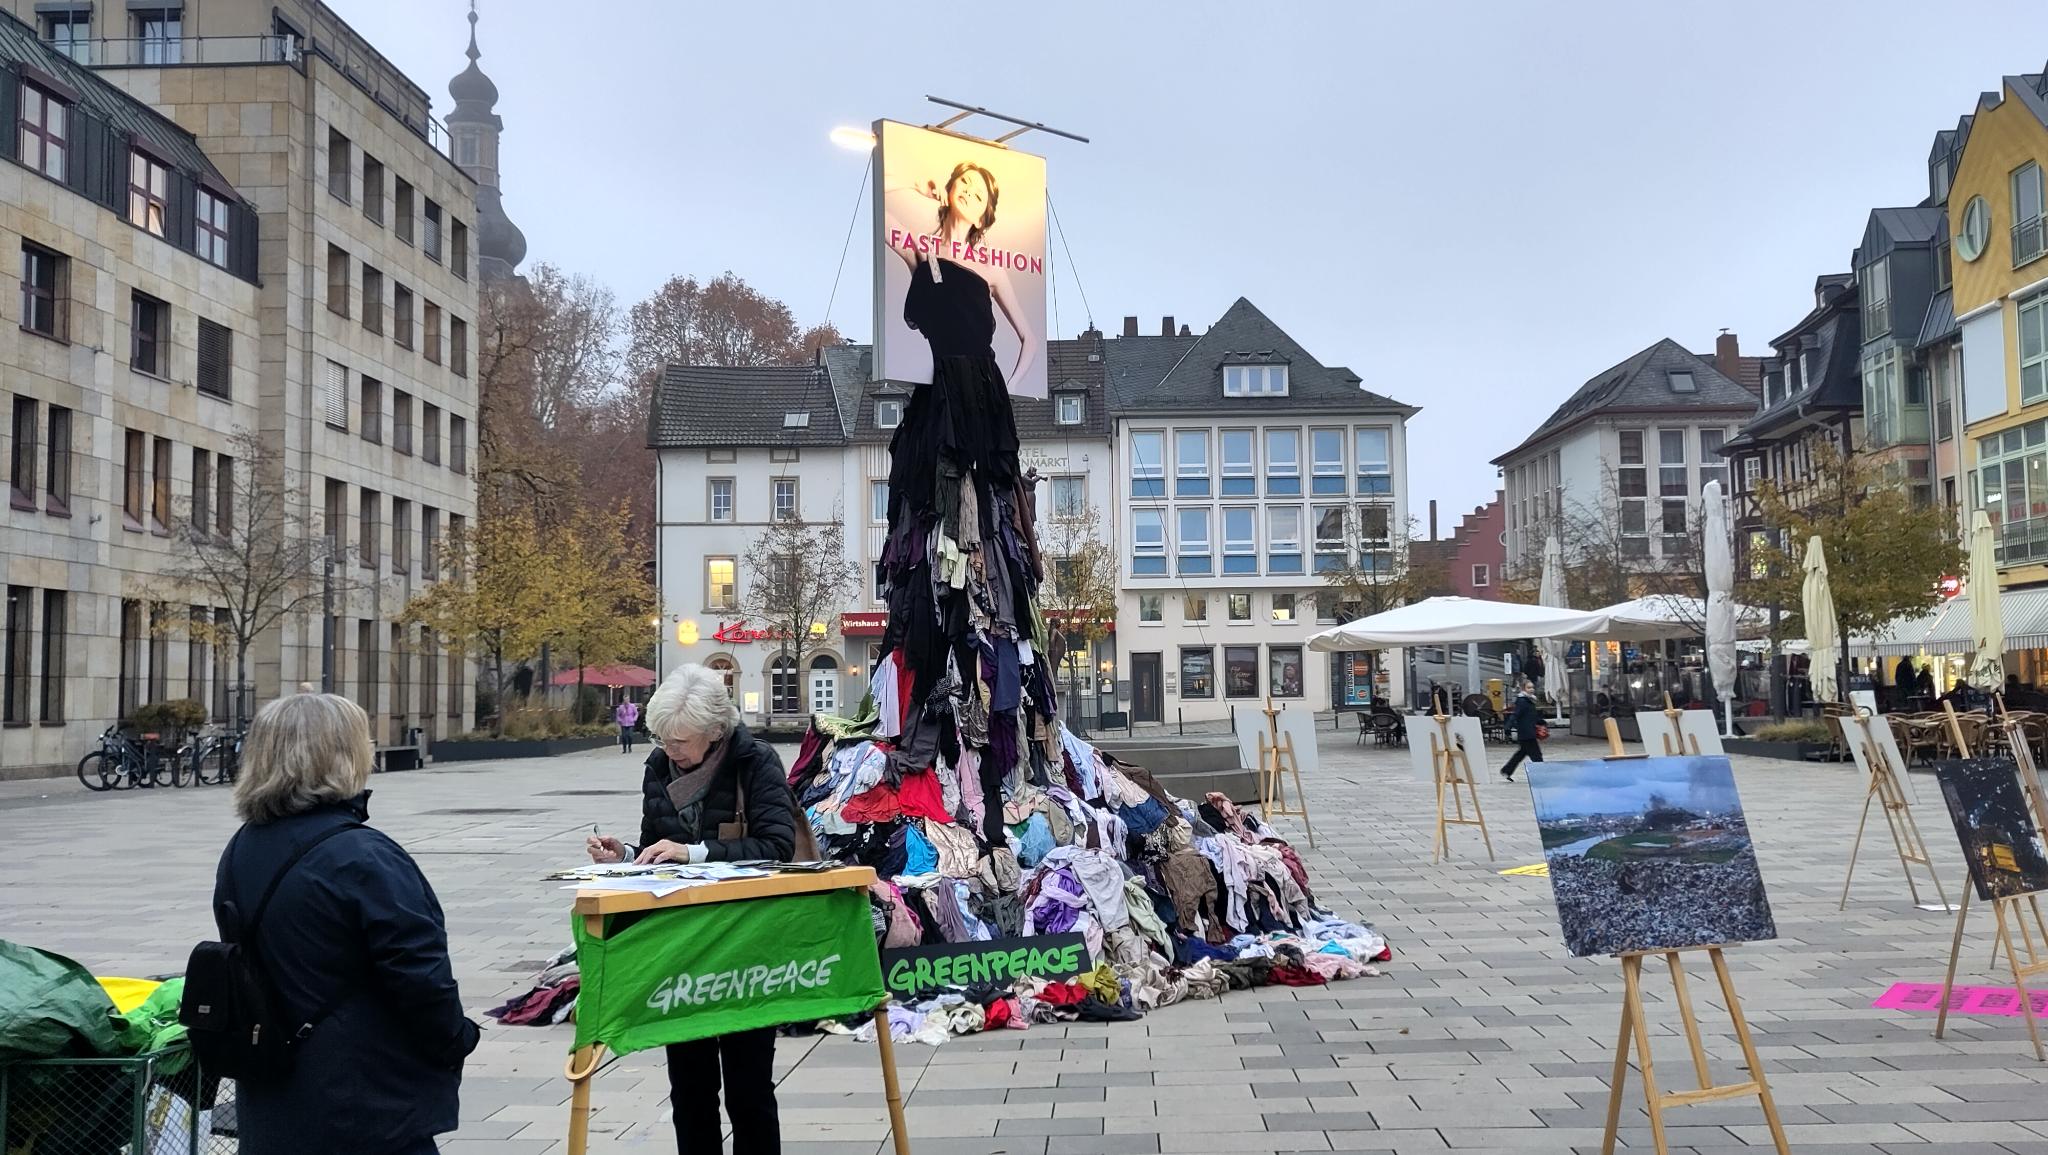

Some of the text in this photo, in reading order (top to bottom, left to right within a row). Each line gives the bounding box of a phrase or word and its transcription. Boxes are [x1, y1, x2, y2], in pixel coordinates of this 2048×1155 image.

[891, 229, 1042, 275] FAST FASHION
[646, 953, 841, 1015] GREENPEACE
[888, 942, 1085, 995] GREENPEACE
